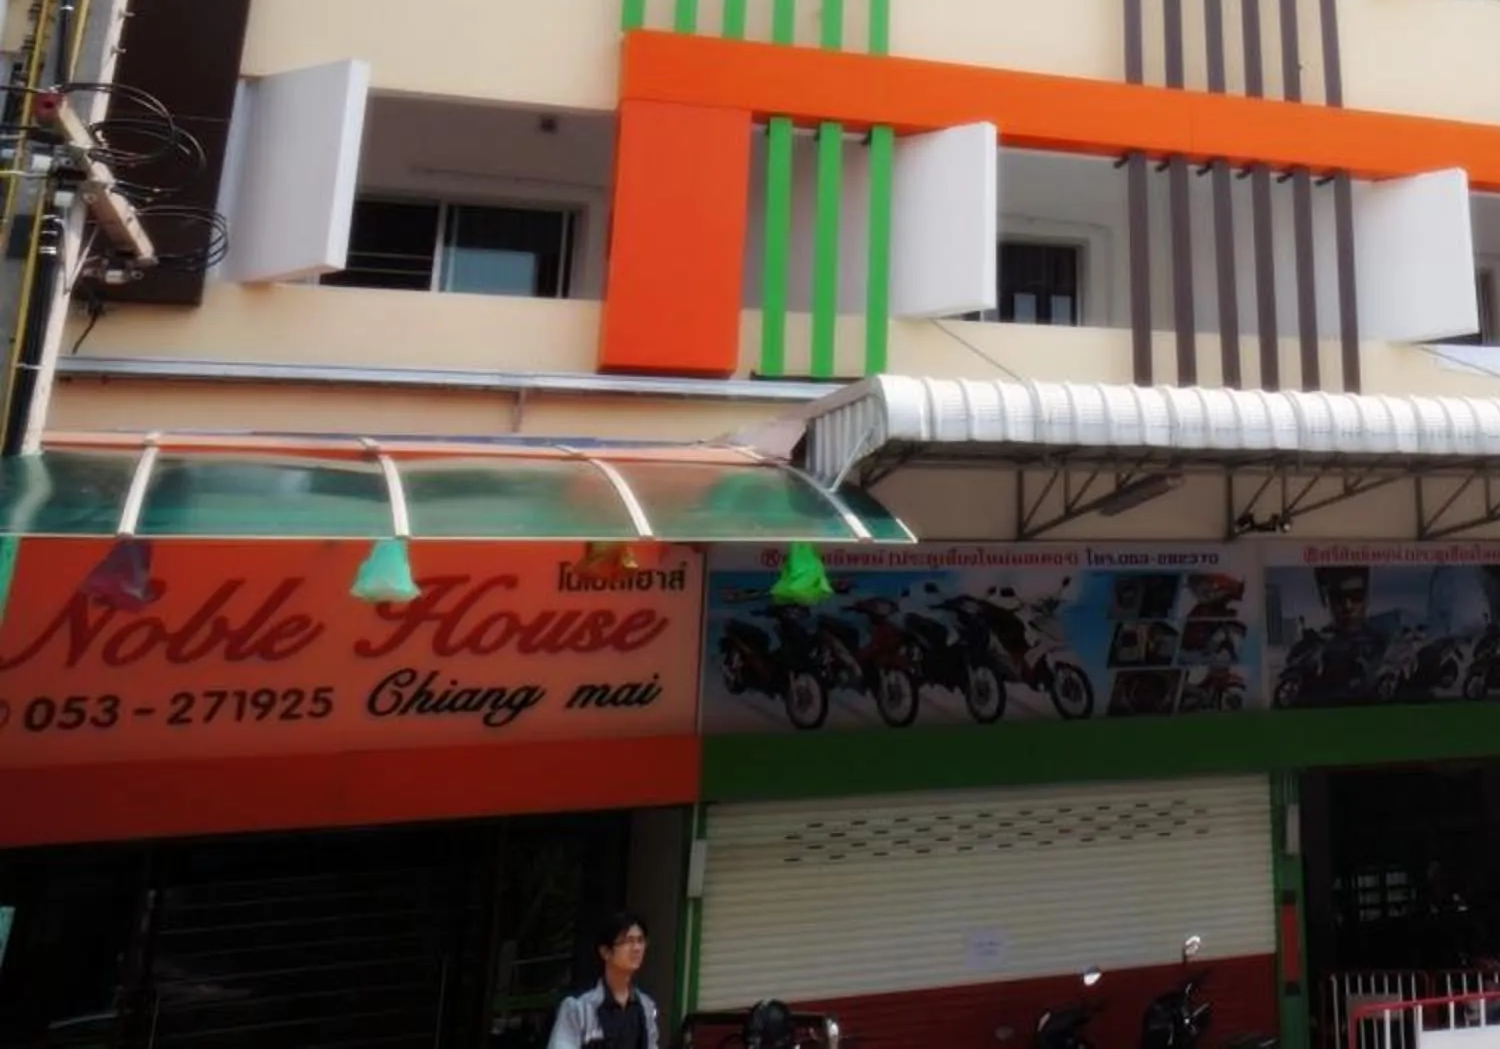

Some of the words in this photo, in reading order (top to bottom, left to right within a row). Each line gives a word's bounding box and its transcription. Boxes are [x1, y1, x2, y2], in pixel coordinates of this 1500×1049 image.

[0, 577, 327, 671] Noble
[354, 575, 670, 659] House
[366, 668, 546, 727] Chiang
[565, 673, 661, 709] mai
